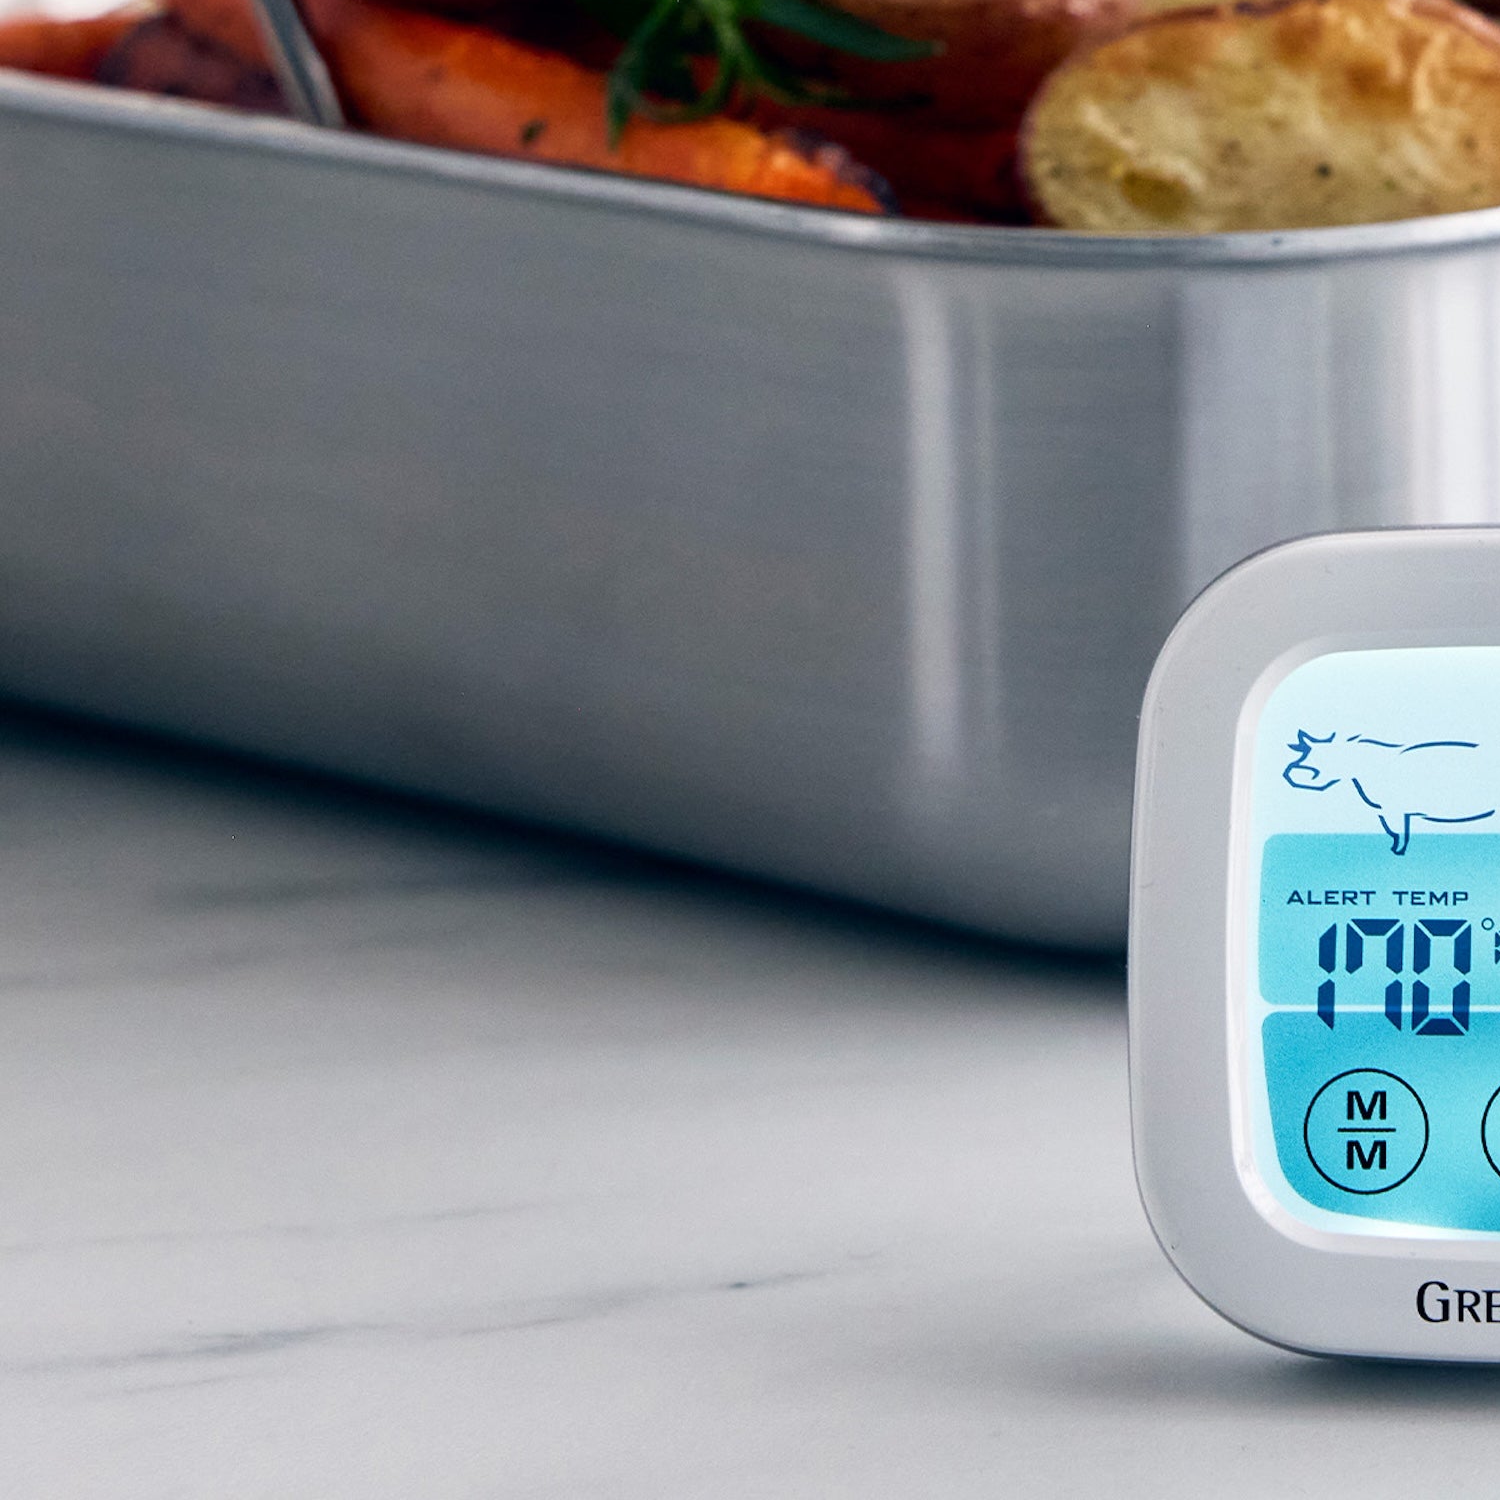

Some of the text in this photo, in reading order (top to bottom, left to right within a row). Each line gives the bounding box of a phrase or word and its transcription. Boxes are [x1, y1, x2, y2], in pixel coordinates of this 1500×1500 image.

[1287, 890, 1469, 906] ALERT TEMP
[1346, 1090, 1387, 1120] M
[1346, 1140, 1387, 1170] M
